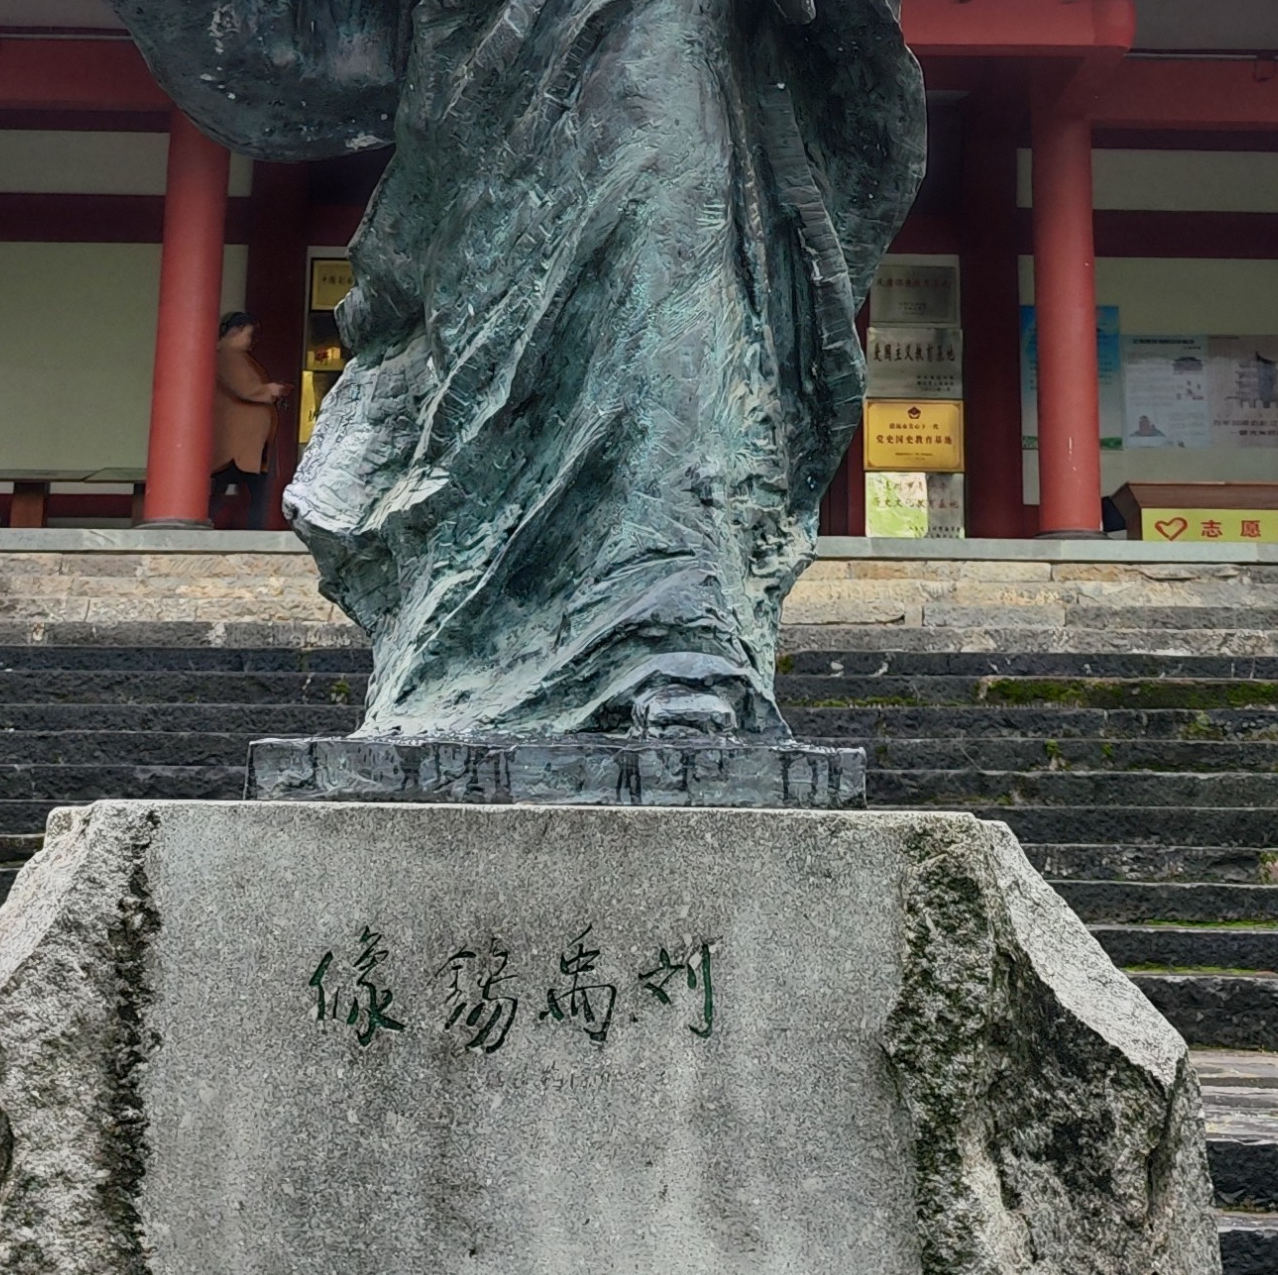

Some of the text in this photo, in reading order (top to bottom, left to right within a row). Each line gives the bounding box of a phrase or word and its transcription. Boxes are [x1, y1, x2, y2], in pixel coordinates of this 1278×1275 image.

[875, 434, 953, 445] 党史国史教育基地
